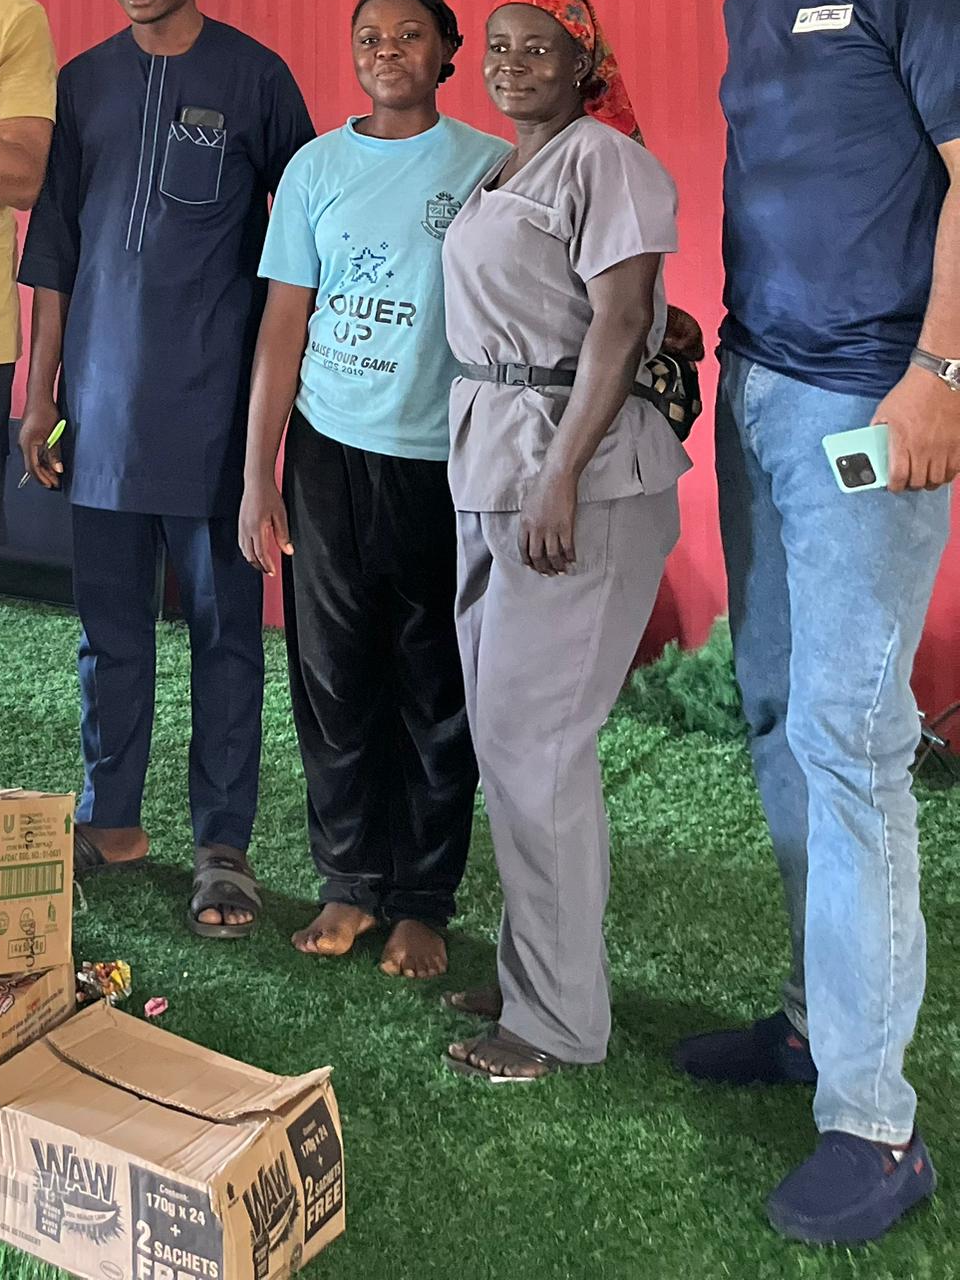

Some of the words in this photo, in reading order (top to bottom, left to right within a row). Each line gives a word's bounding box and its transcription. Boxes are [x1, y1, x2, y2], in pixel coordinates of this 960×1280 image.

[329, 293, 417, 327] OWER
[333, 320, 373, 346] UP
[311, 341, 331, 358] RAISE
[332, 349, 358, 366] YOUR
[360, 357, 398, 373] GAME
[341, 366, 364, 376] 2019
[29, 1137, 117, 1205] WAW
[242, 1150, 291, 1243] WAW
[305, 1175, 315, 1206] 2
[306, 1178, 343, 1232] FREE
[146, 1192, 176, 1218] 170g
[189, 1207, 206, 1226] 24
[136, 1219, 152, 1254] 2
[153, 1240, 219, 1278] SACHETS
